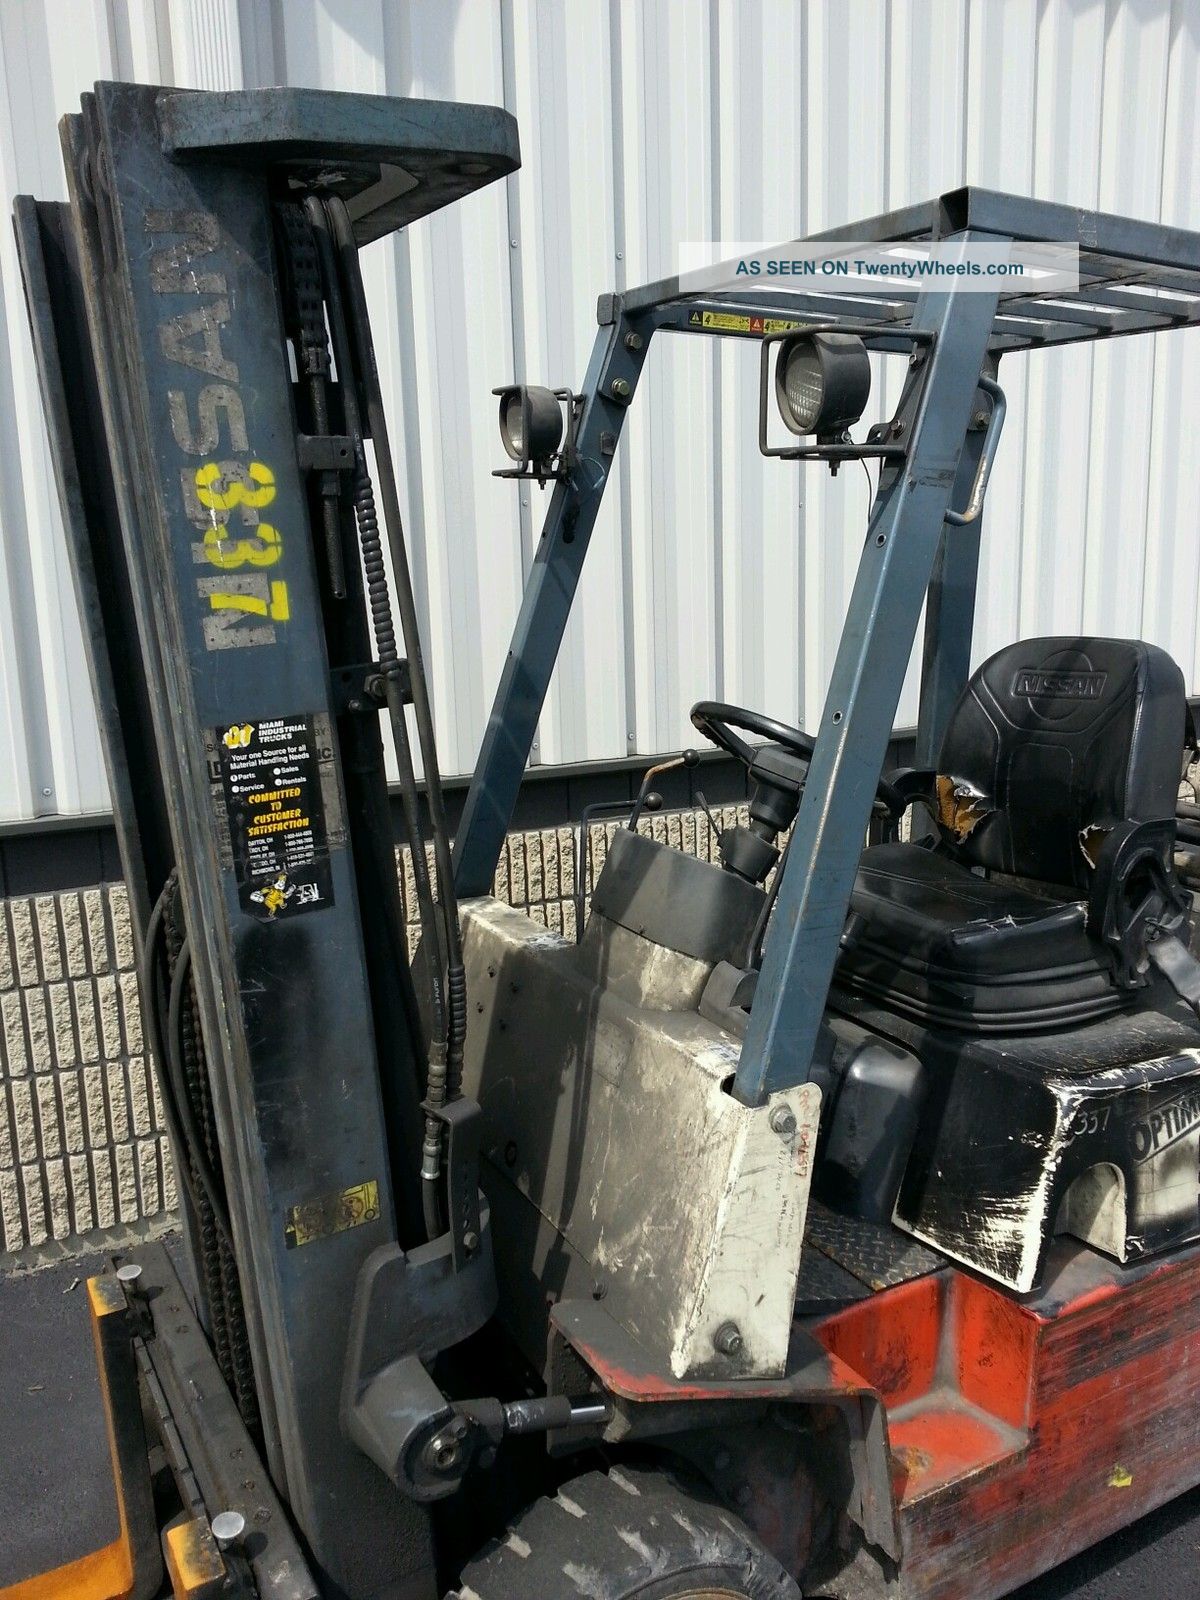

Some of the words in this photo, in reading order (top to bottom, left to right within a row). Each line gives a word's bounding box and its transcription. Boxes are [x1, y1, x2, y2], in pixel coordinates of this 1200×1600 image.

[195, 460, 290, 622] 337
[1018, 673, 1102, 696] NISSAN
[258, 720, 285, 730] MIAMI
[258, 724, 308, 736] INDUSTRIAL
[258, 733, 293, 743] TRUCKS
[231, 752, 248, 763] Your
[249, 752, 262, 760] one
[263, 747, 287, 758] Source
[287, 746, 298, 754] for
[298, 744, 307, 752] all
[230, 761, 257, 770] Material
[258, 756, 289, 767] Handling
[289, 752, 310, 762] Needs
[238, 772, 256, 780] Parts
[281, 766, 299, 774] Sales
[239, 783, 265, 792] Service
[282, 776, 307, 786] Rentals
[248, 787, 301, 804] COMMITTED
[271, 801, 282, 811] TO
[253, 808, 302, 825] CUSTOMER
[247, 817, 310, 836] SATISFACTION
[1074, 1106, 1112, 1136] 337
